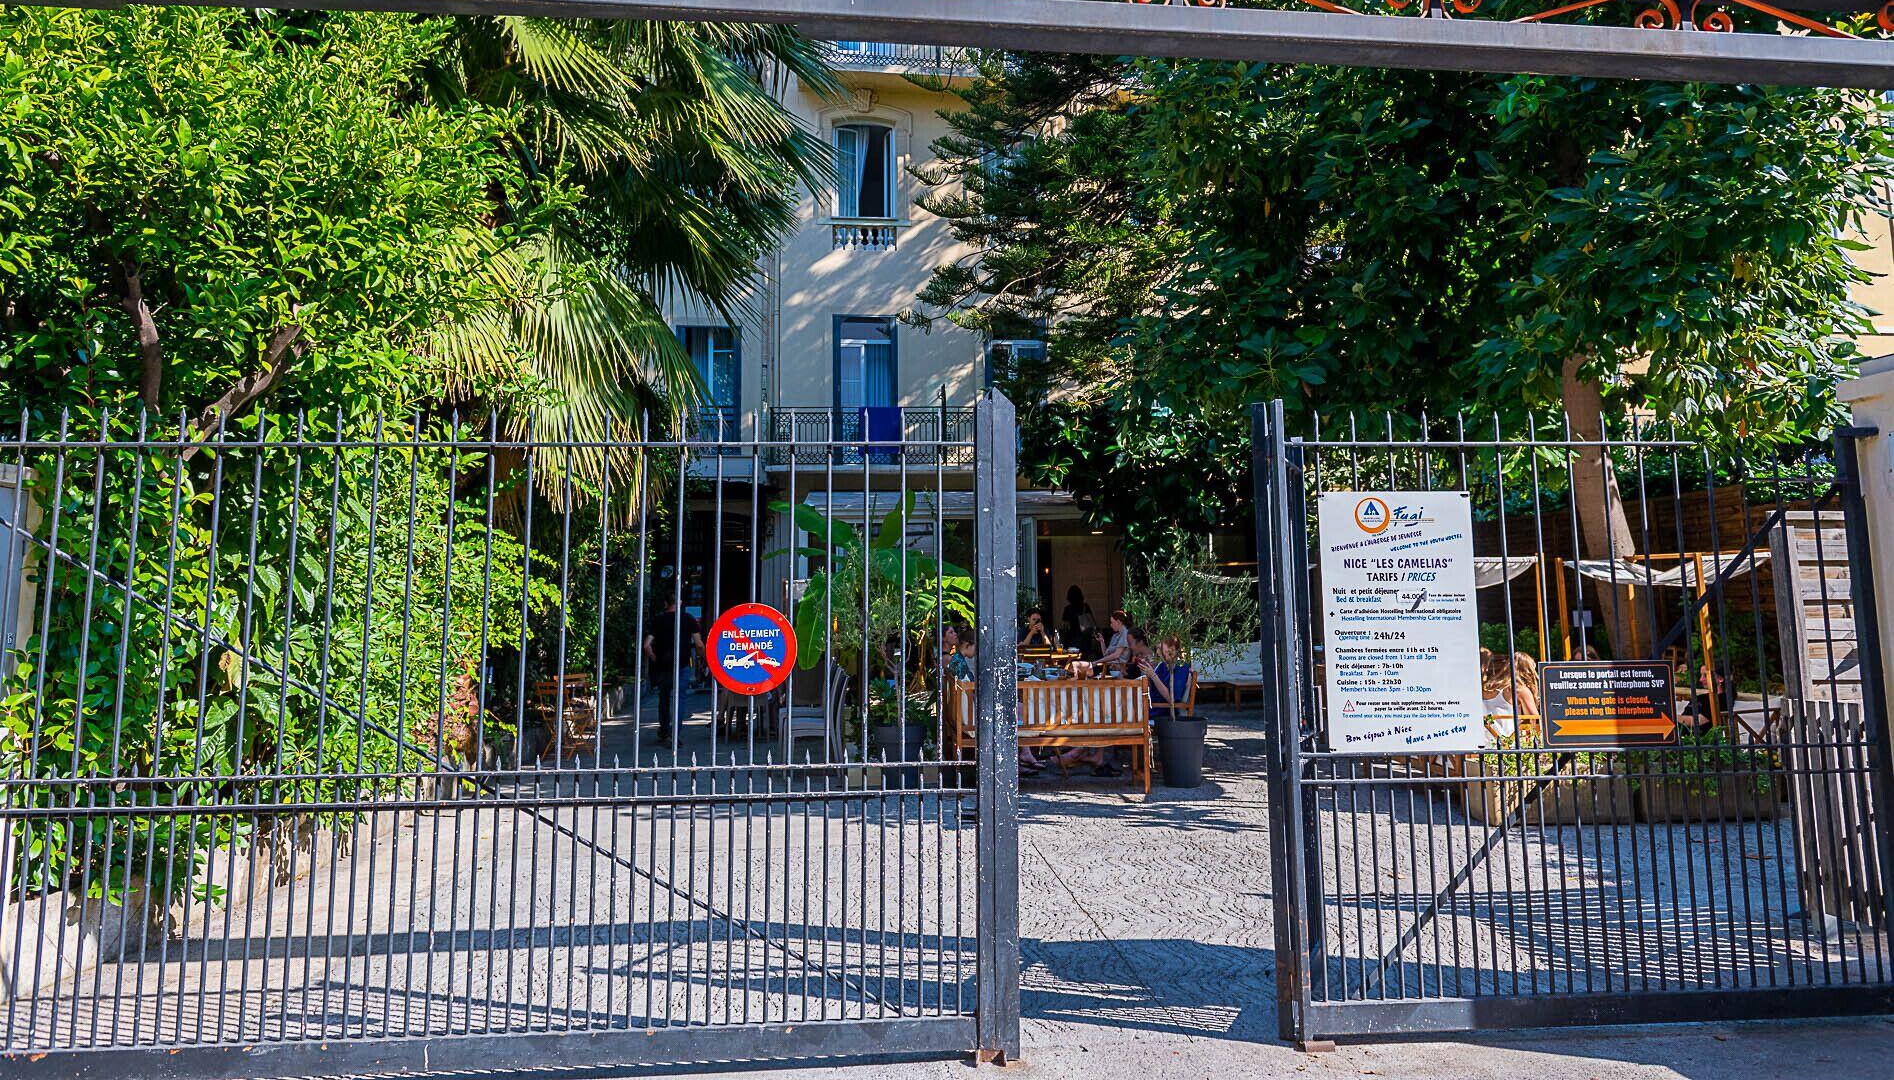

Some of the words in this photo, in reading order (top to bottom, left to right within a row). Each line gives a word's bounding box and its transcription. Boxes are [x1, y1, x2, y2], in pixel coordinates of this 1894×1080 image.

[1398, 531, 1422, 540] JEUNESSE
[1445, 533, 1462, 541] HOSTEL
[1343, 558, 1367, 568] NICE
[1366, 572, 1398, 582] TARIFS
[1407, 572, 1436, 582] PRICES
[1358, 587, 1372, 595] petit
[1374, 587, 1399, 596] déjeuner
[722, 627, 780, 639] ENLÈVEMENT
[1373, 631, 1406, 640] 24h/24
[729, 640, 774, 651] DEMANDÉ
[1559, 670, 1587, 680] Lorsque
[1596, 670, 1619, 680] portail
[1620, 670, 1631, 678] est
[1632, 669, 1654, 678] fermé,
[1550, 680, 1577, 690] veuillez
[1578, 681, 1601, 689] sonner
[1603, 680, 1608, 689] à
[1609, 679, 1650, 689] l'interphone
[1651, 680, 1665, 688] SVP
[1566, 696, 1587, 705] When
[1588, 696, 1599, 705] the
[1600, 696, 1616, 706] gate
[1618, 696, 1624, 704] is
[1564, 707, 1588, 717] please
[1589, 706, 1603, 717] ring
[1605, 706, 1616, 715] the
[1617, 706, 1654, 716] interphone
[1345, 734, 1361, 743] Bon
[1363, 731, 1385, 742] séjour
[1394, 726, 1412, 735] Nice
[1405, 735, 1424, 744] Have
[1433, 729, 1449, 738] nice
[1450, 724, 1467, 734] stay
